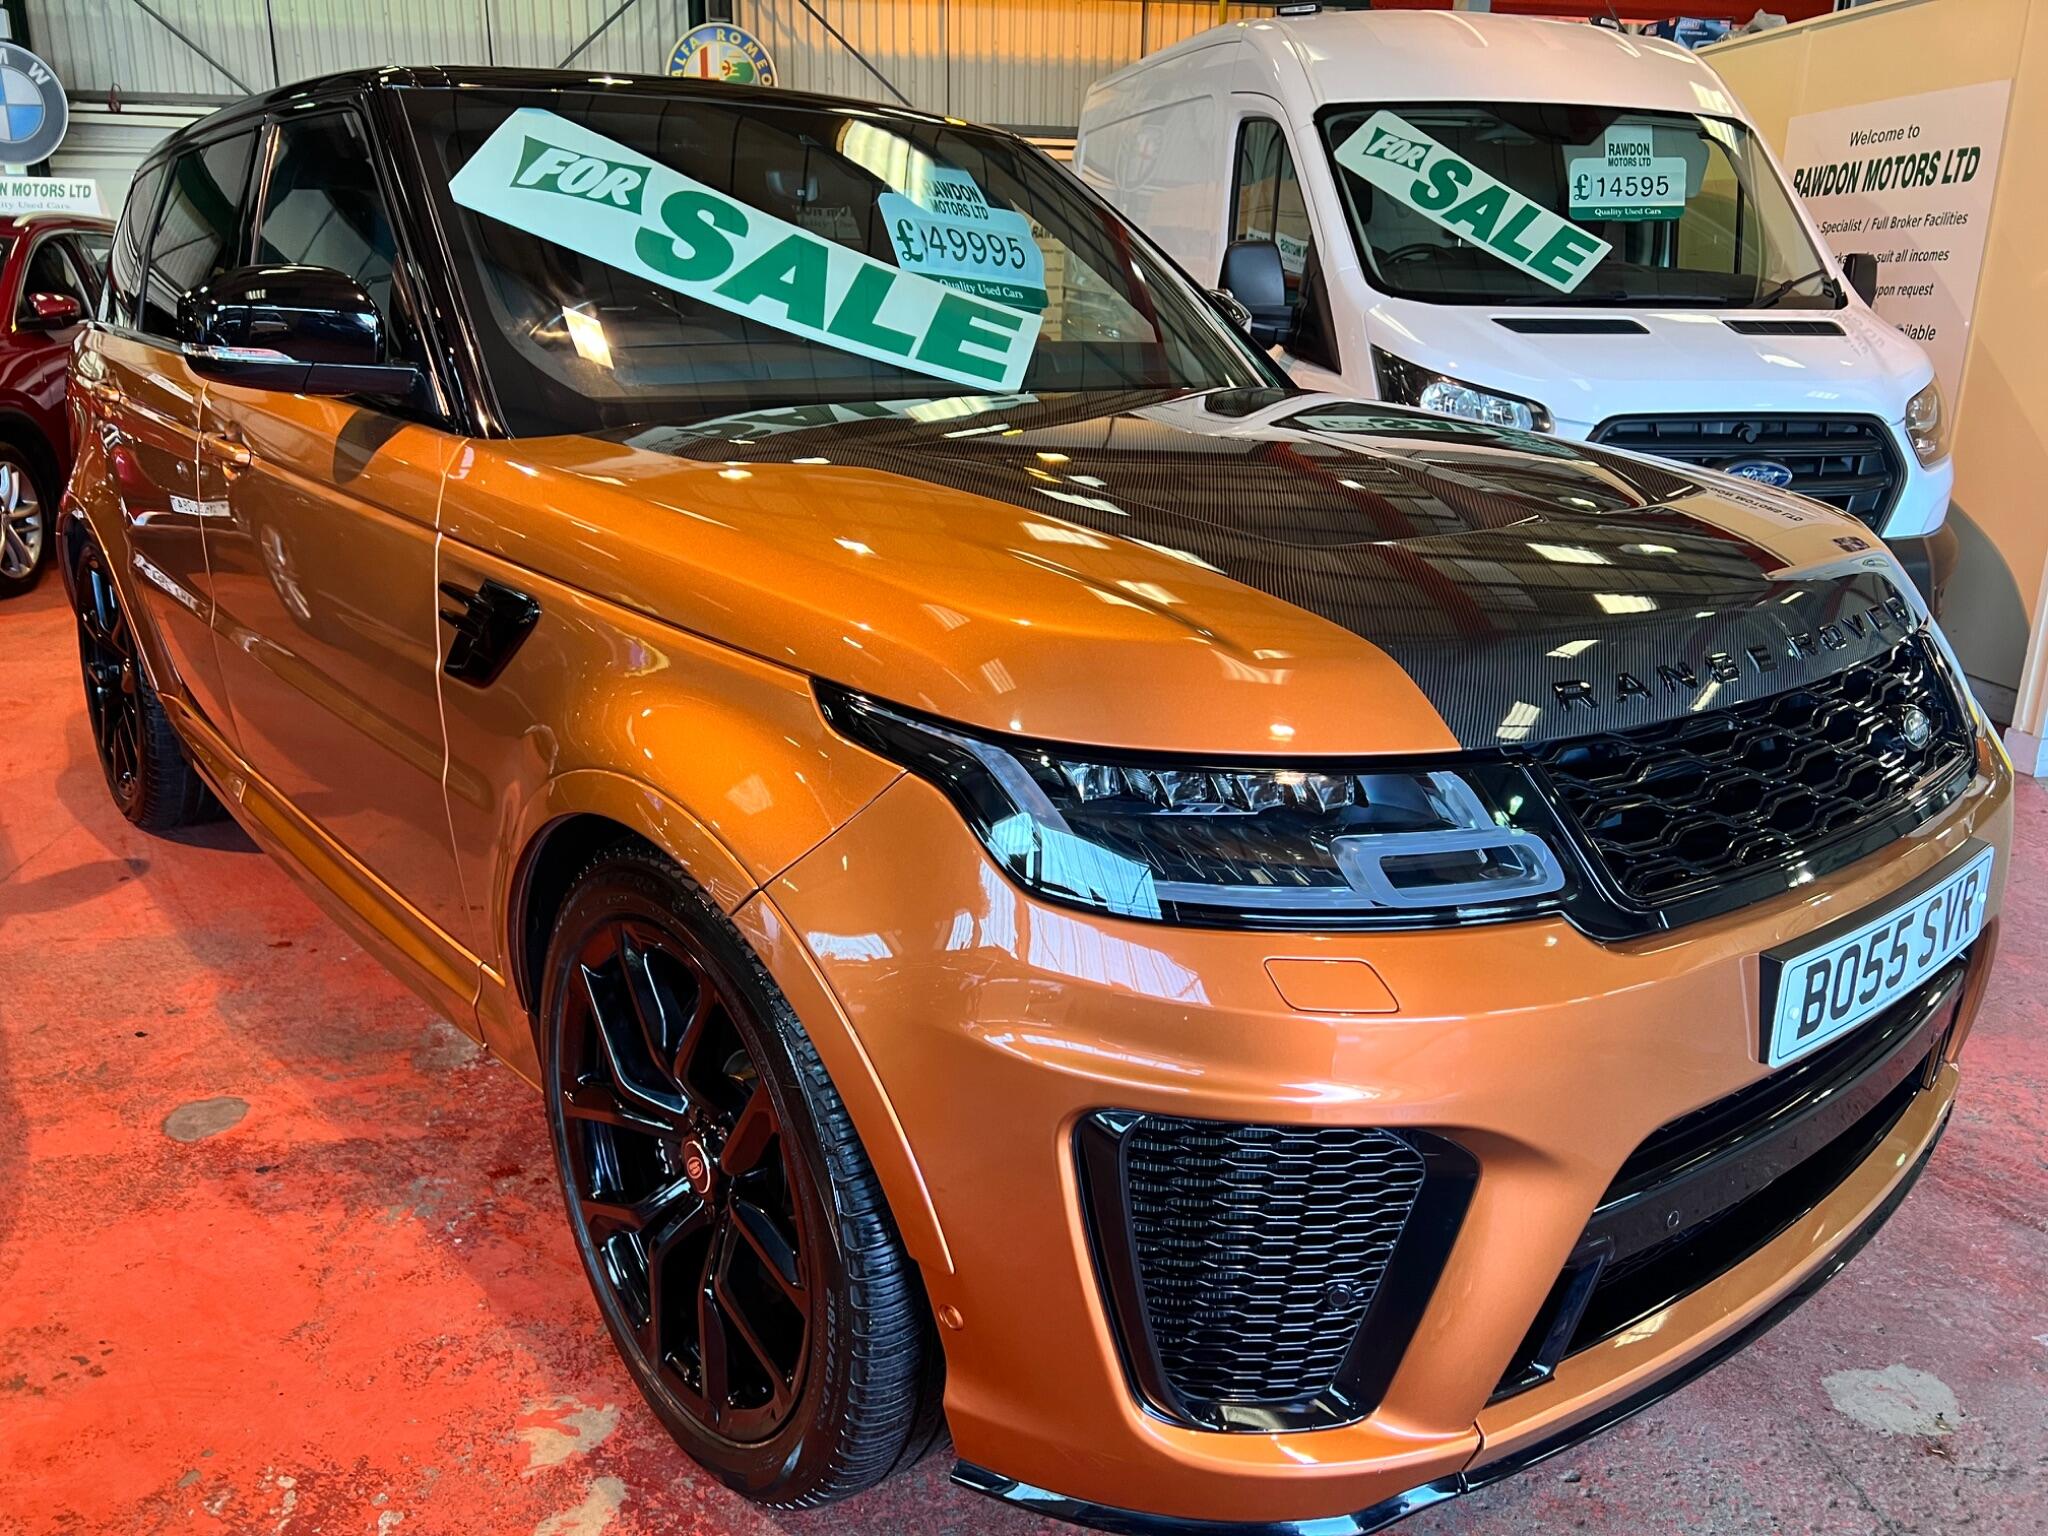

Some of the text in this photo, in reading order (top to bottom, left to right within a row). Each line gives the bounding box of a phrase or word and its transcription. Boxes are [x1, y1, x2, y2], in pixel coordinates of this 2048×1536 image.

[716, 28, 773, 86] ROMEO
[1849, 124, 1921, 147] Welcome to
[1608, 143, 1650, 156] RAWDON
[1607, 157, 1652, 167] MOTORS LTD
[1793, 146, 1981, 198] RAWDON MOTORS LTD
[12, 183, 65, 197] MOTORS
[69, 184, 92, 198] LTD
[923, 179, 982, 204] RAWDON
[929, 199, 989, 220] MOTORS LTD
[1366, 133, 1601, 285] FOR SALE
[1594, 207, 1662, 217] Quality Used Cars
[1820, 211, 1968, 236] Specialist / Full Broker Facilities
[517, 147, 1023, 383] FOR SALE
[1876, 248, 1950, 263] suit all incomes
[939, 279, 1024, 300] Quality Used Cars
[1896, 282, 1934, 299] request
[1899, 323, 1936, 341] ilable
[1552, 597, 1913, 712] RANGE ROVER
[1918, 869, 1979, 969] SVR
